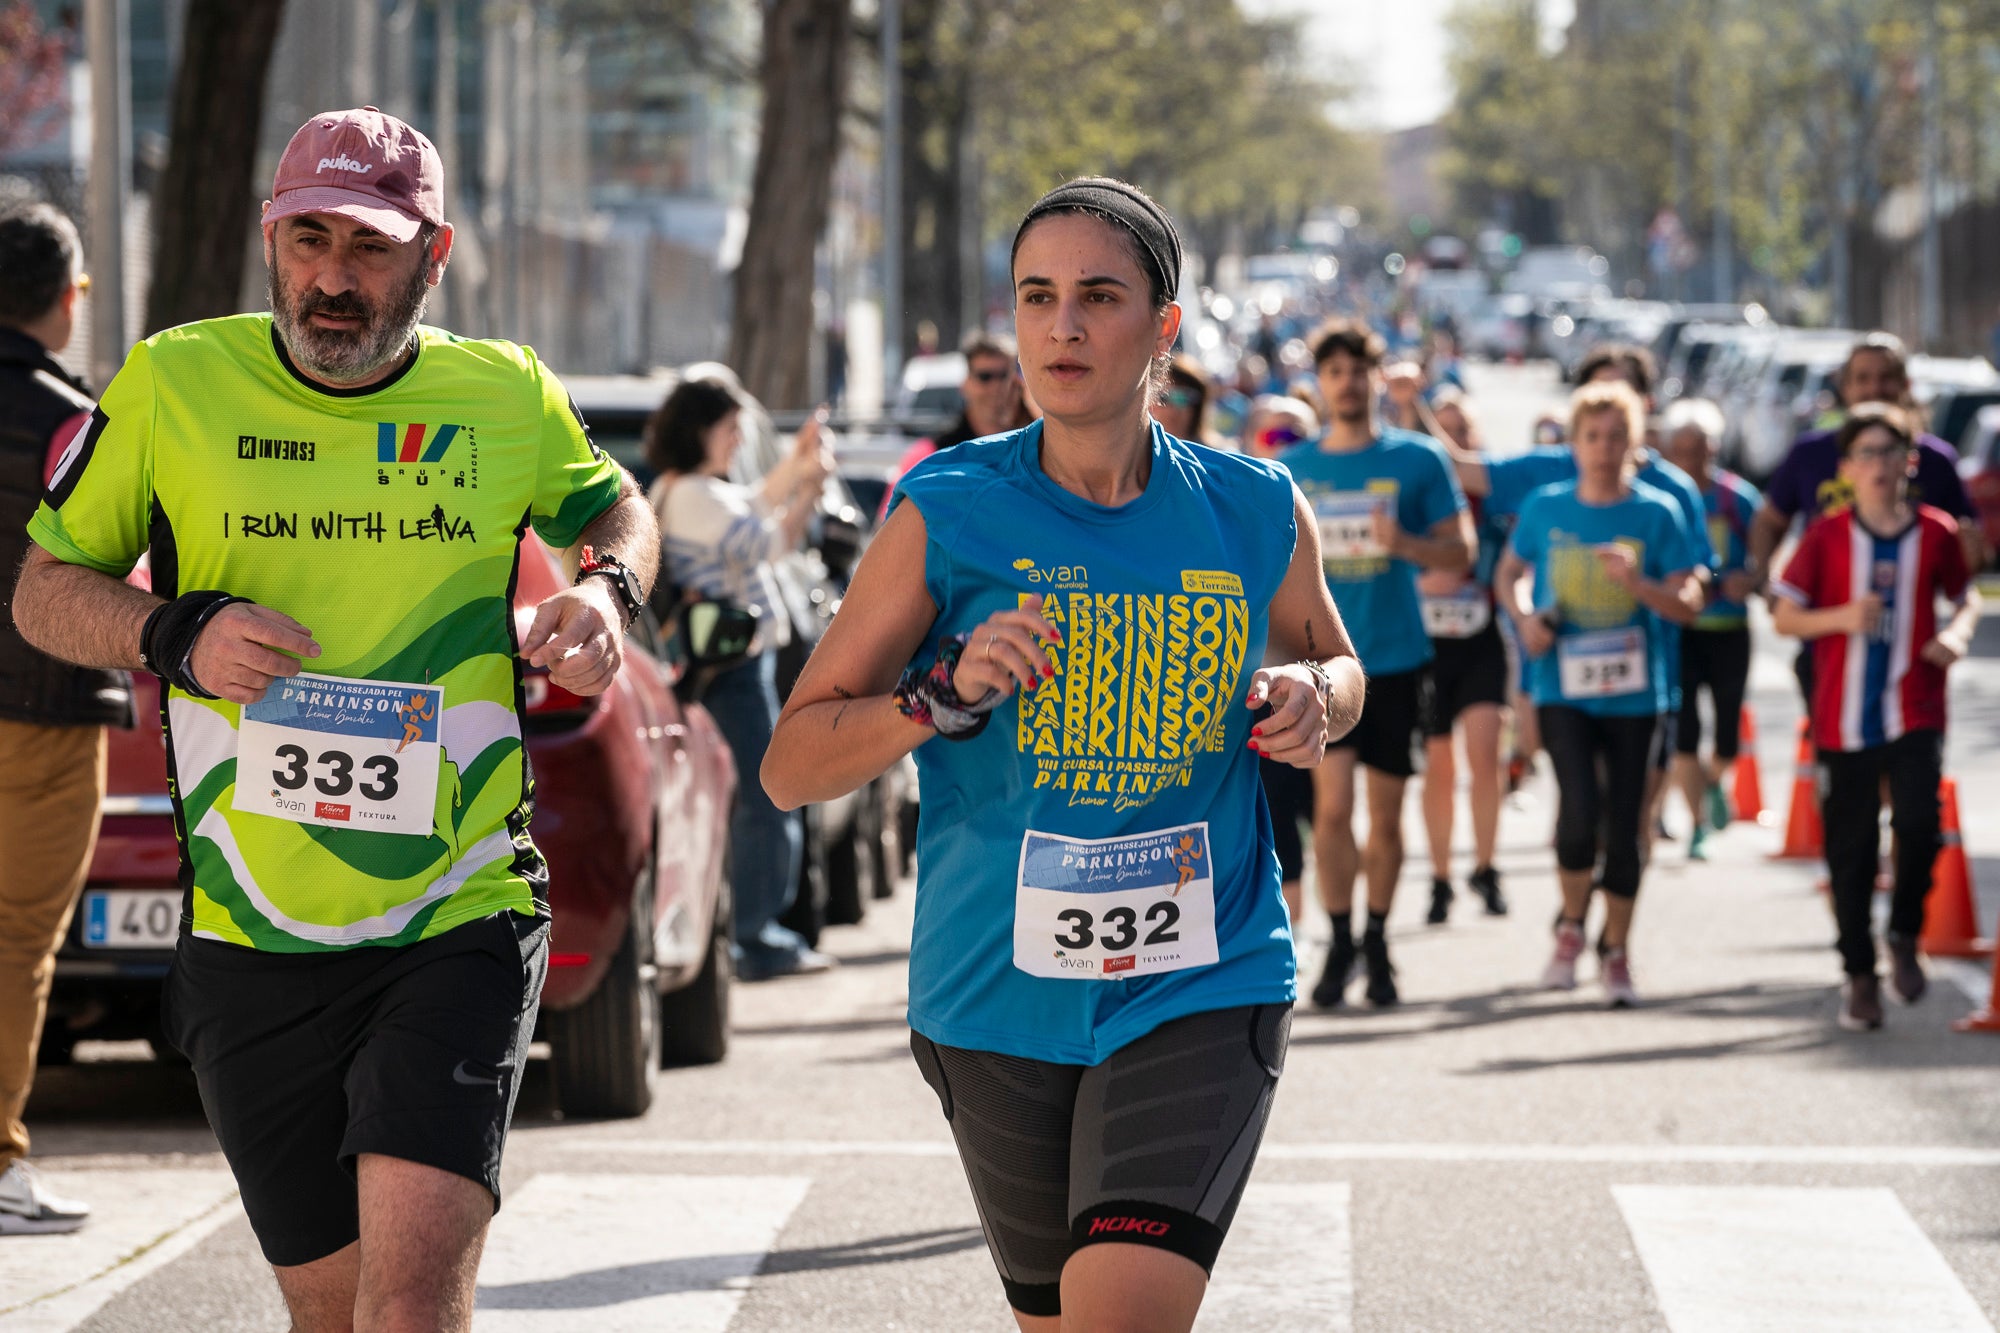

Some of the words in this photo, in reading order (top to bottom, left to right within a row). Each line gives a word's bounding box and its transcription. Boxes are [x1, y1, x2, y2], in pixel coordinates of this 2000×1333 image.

[258, 438, 316, 461] INVERSE
[468, 426, 478, 489] BARCELONA
[377, 468, 465, 478] GRUPO
[377, 475, 465, 488] SUR
[224, 512, 229, 538] I
[241, 511, 297, 539] RUN
[311, 510, 387, 543] WITH
[1027, 565, 1088, 583] avan
[1054, 581, 1088, 590] neurologia
[1201, 581, 1240, 592] Terrassa
[335, 685, 387, 697] PASSEJADA
[387, 689, 403, 698] PEL
[281, 688, 404, 713] PARKINSON
[1213, 724, 1226, 753] 2025
[272, 743, 399, 801] 333
[1037, 758, 1059, 771] VIII
[1062, 759, 1104, 771] CURSA
[1107, 761, 1113, 771] I
[1033, 768, 1193, 794] PARKINSON
[275, 797, 306, 812] avan
[358, 811, 397, 821] TEXTURA
[1113, 839, 1158, 851] PASSEJADA
[1159, 835, 1172, 844] PEL
[1062, 845, 1174, 869] PARKINSON
[1054, 900, 1181, 951] 332
[1060, 958, 1094, 969] avan
[1142, 953, 1181, 964] TEXTURA
[1088, 1216, 1171, 1237] HOKO
